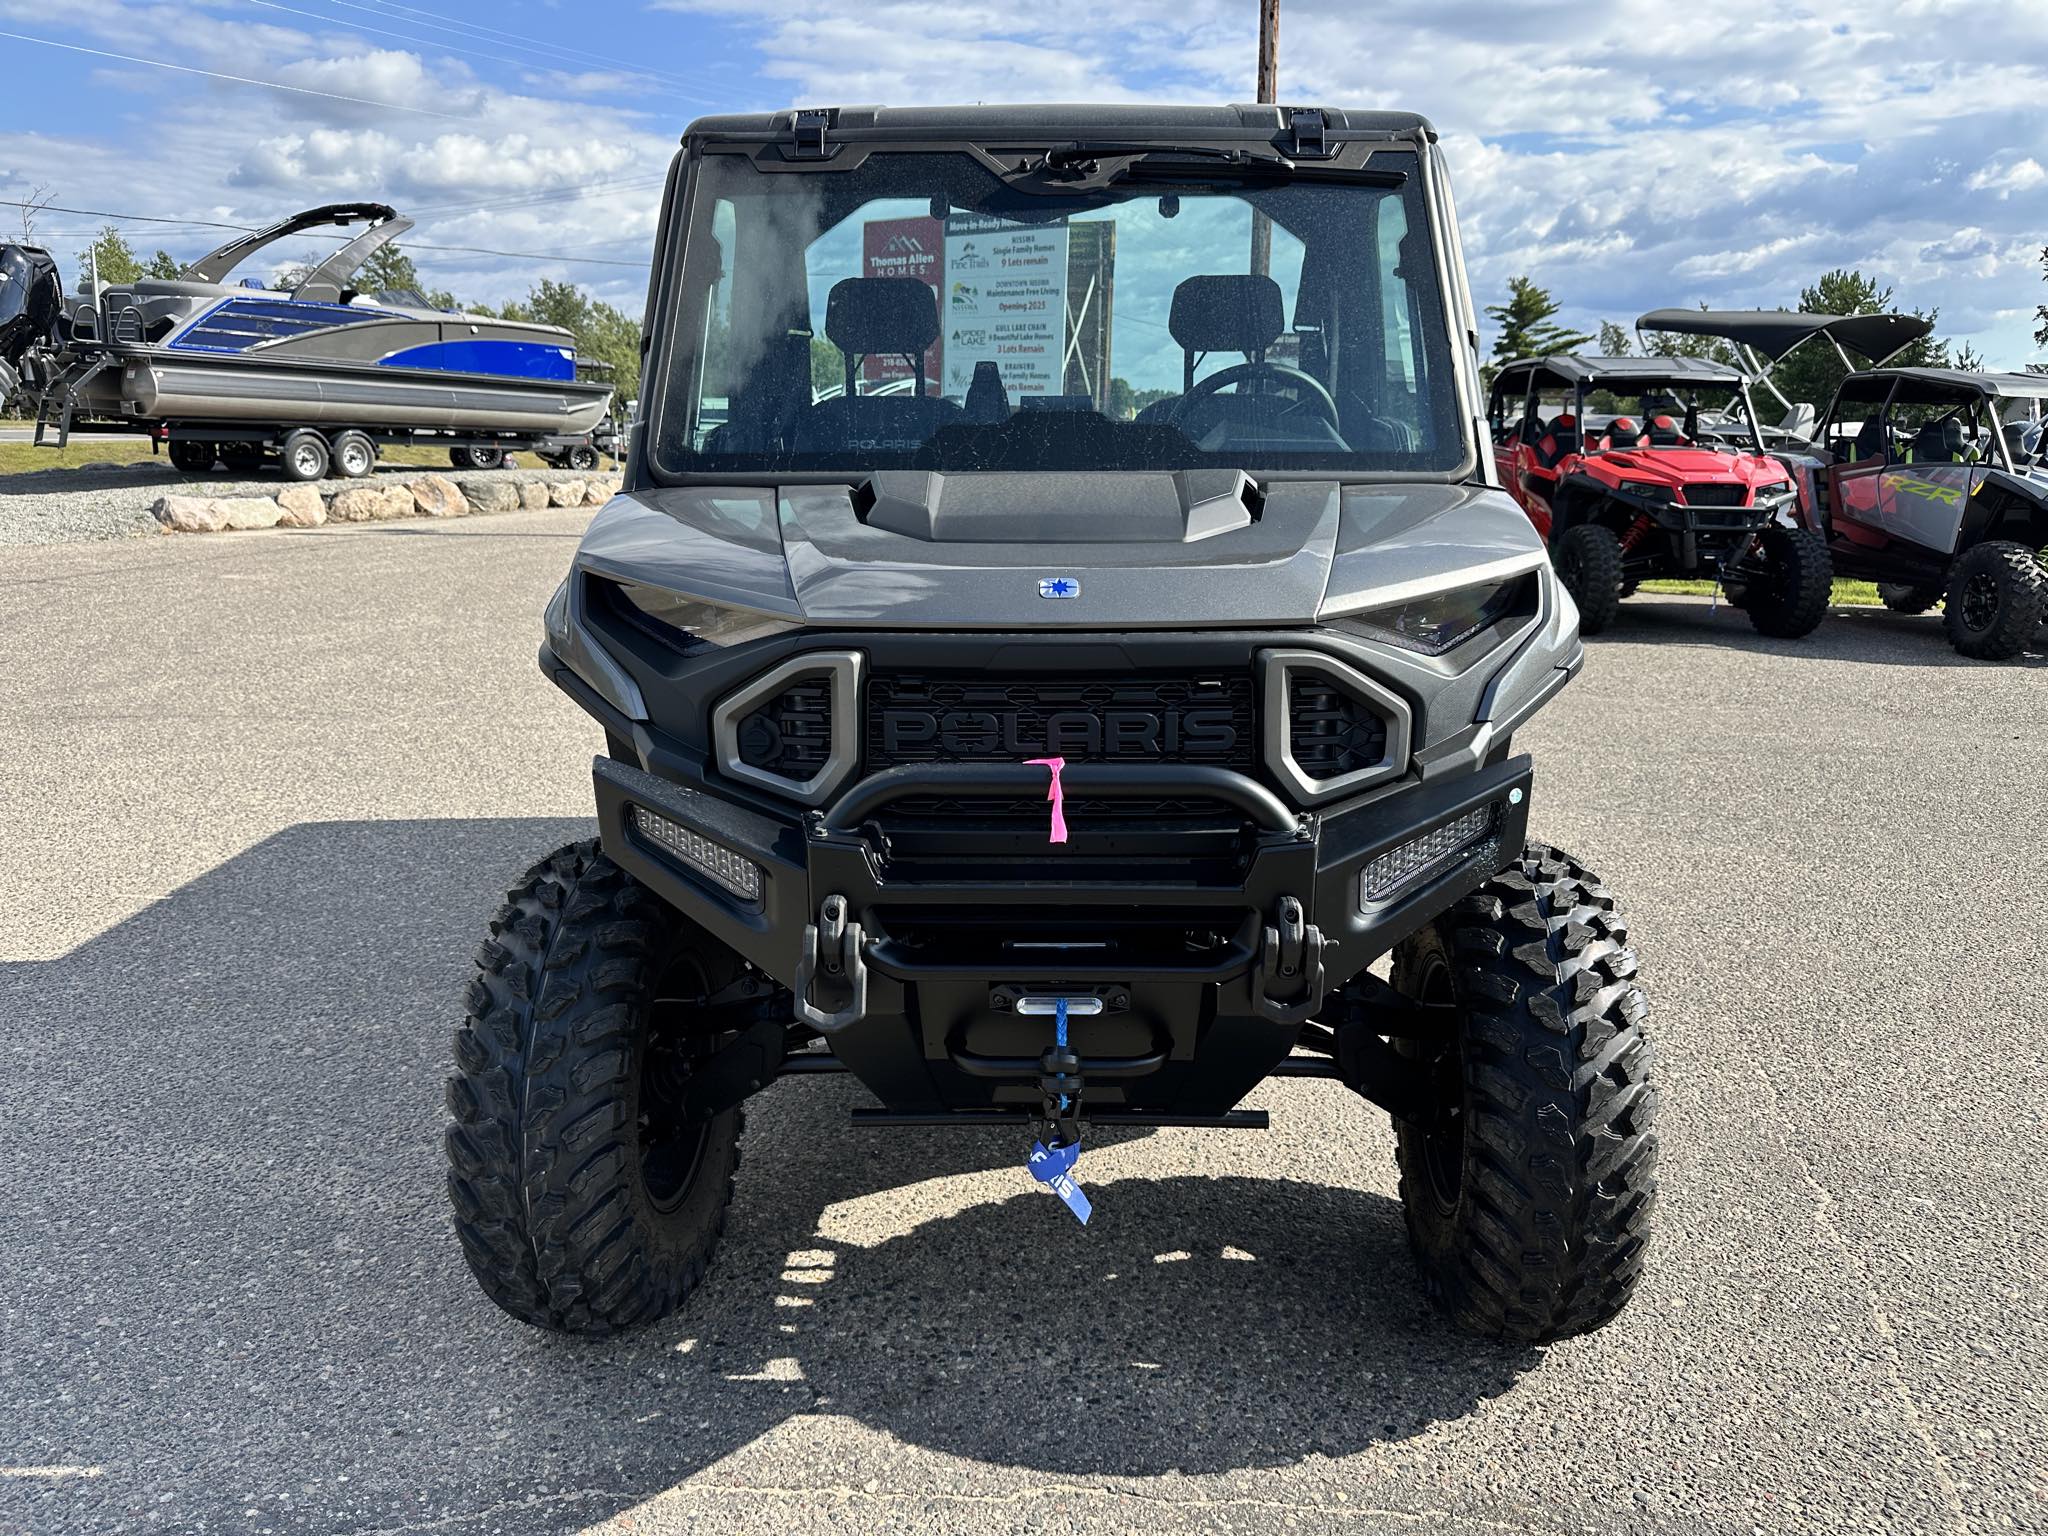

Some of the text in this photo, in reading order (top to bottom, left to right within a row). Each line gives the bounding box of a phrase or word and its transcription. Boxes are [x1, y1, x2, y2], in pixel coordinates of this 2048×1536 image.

[993, 244, 1055, 256] Single Family Homes
[870, 253, 935, 267] Thomas Allen
[951, 257, 990, 270] Pine Trails
[1008, 258, 1023, 267] Lots
[1023, 256, 1049, 266] remain
[877, 264, 927, 277] HOMES
[986, 287, 1060, 298] Maintenance Free Living
[998, 302, 1027, 313] Opening
[1012, 323, 1026, 332] LAKE
[1027, 323, 1047, 331] CHAIN
[961, 337, 986, 346] LAKE
[1021, 333, 1033, 341] Lake
[1003, 344, 1017, 354] Lots
[1018, 344, 1045, 353] Remain
[1009, 371, 1029, 380] Family
[1018, 382, 1045, 392] Remain
[848, 439, 922, 450] POLARIS
[1883, 475, 1962, 505] RZR
[884, 710, 1237, 752] POLARIS
